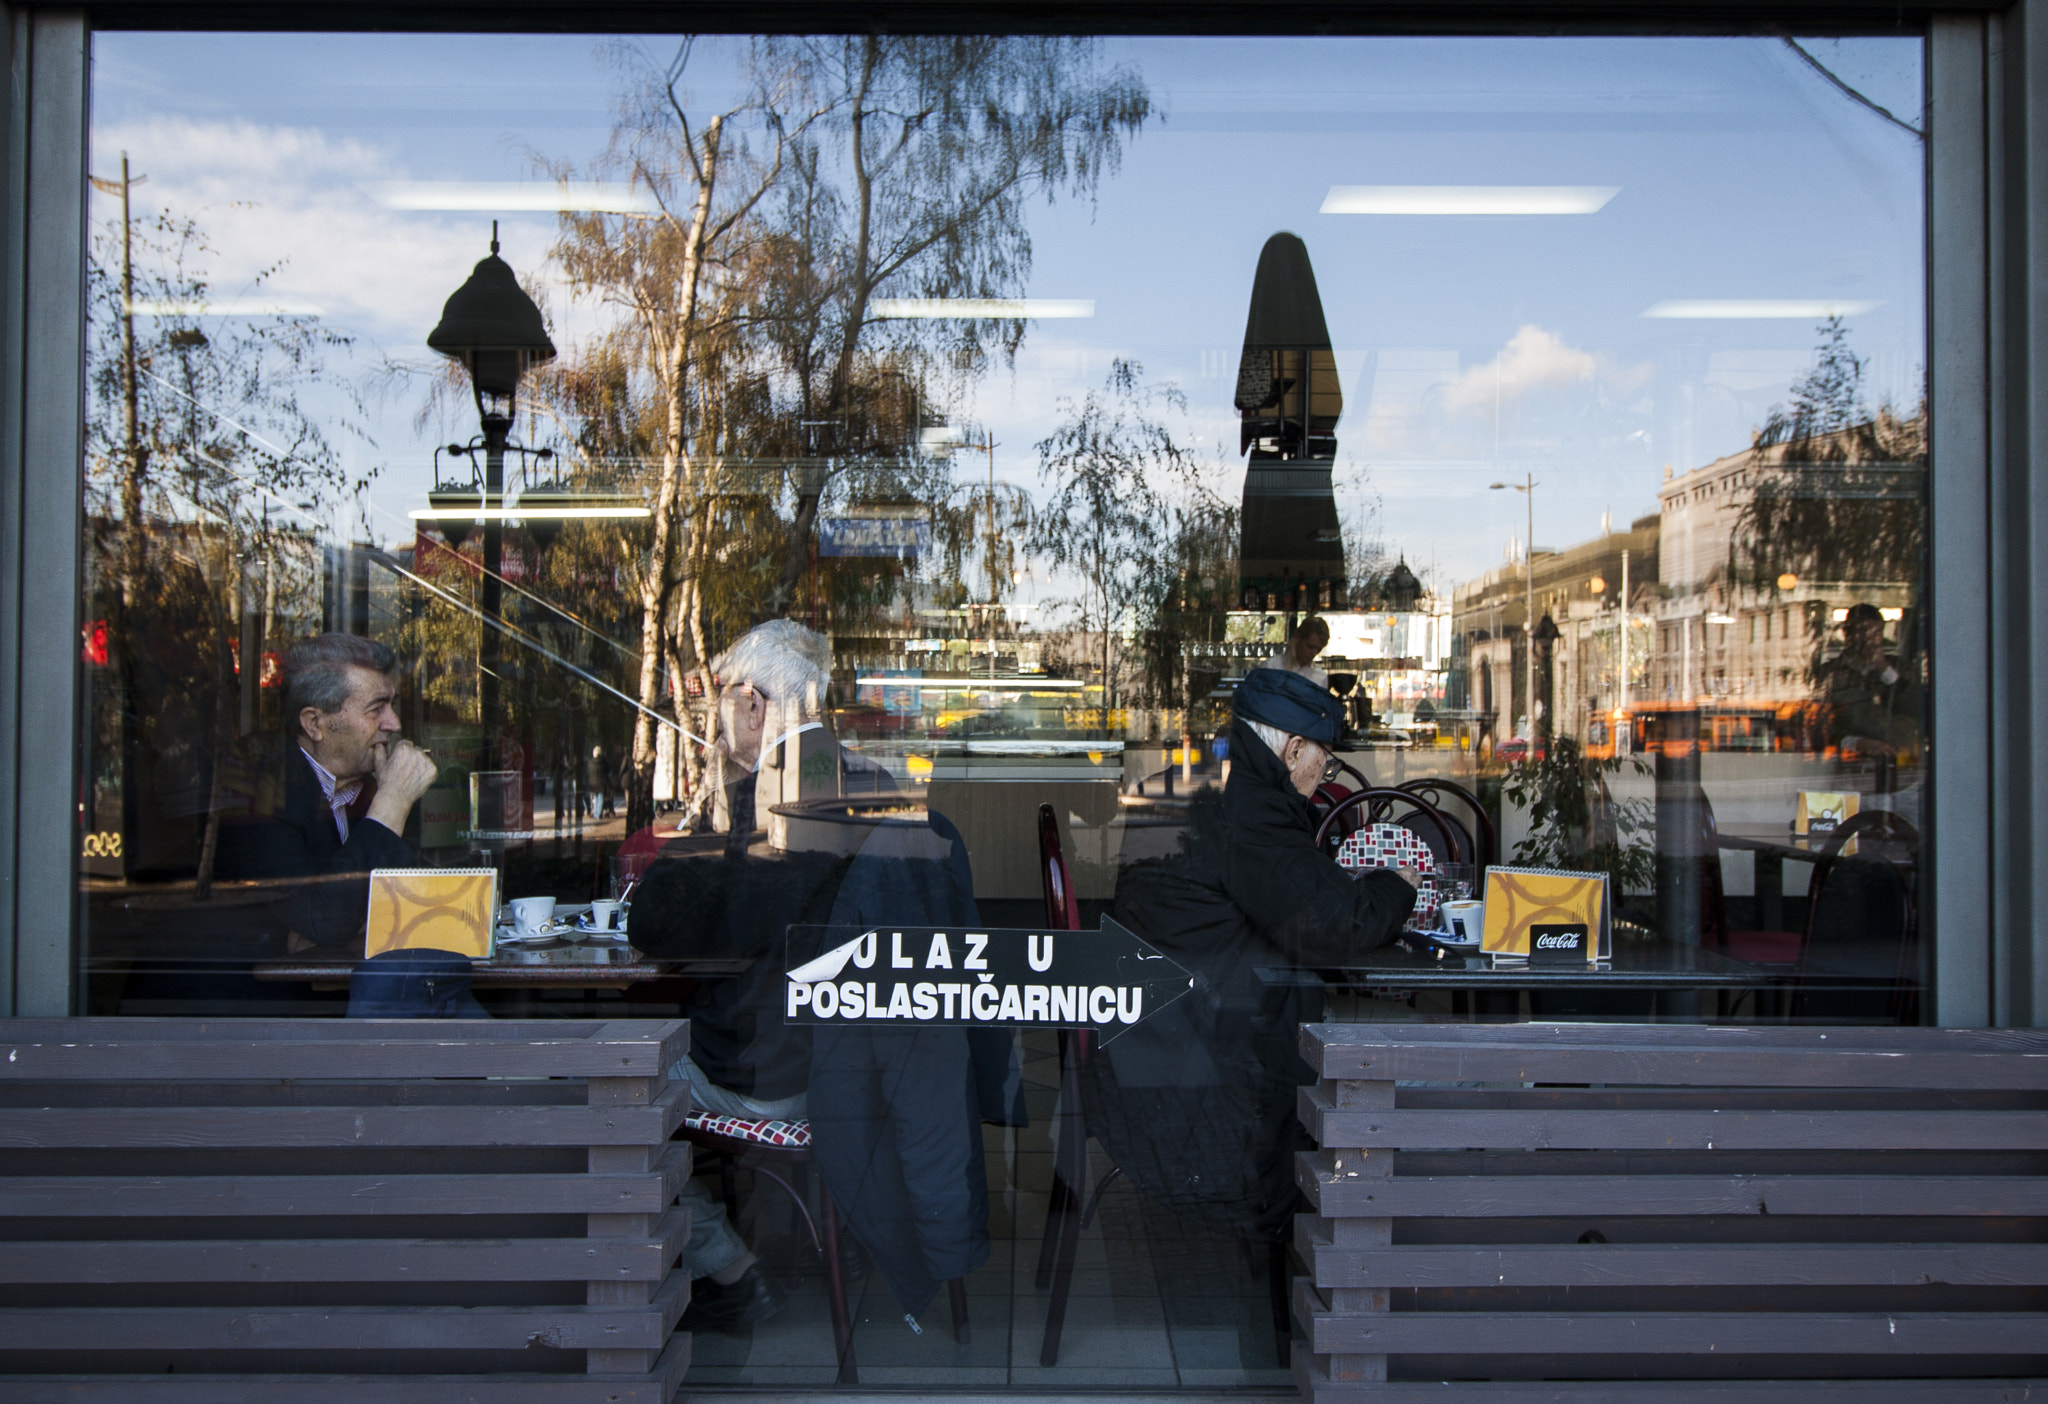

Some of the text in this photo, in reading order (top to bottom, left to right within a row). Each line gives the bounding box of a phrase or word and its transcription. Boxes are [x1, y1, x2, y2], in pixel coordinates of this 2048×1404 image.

[851, 932, 1054, 972] ULAZ U
[1537, 932, 1581, 949] Coca-Cola
[787, 974, 1142, 1024] POSLASTIČARNICU
